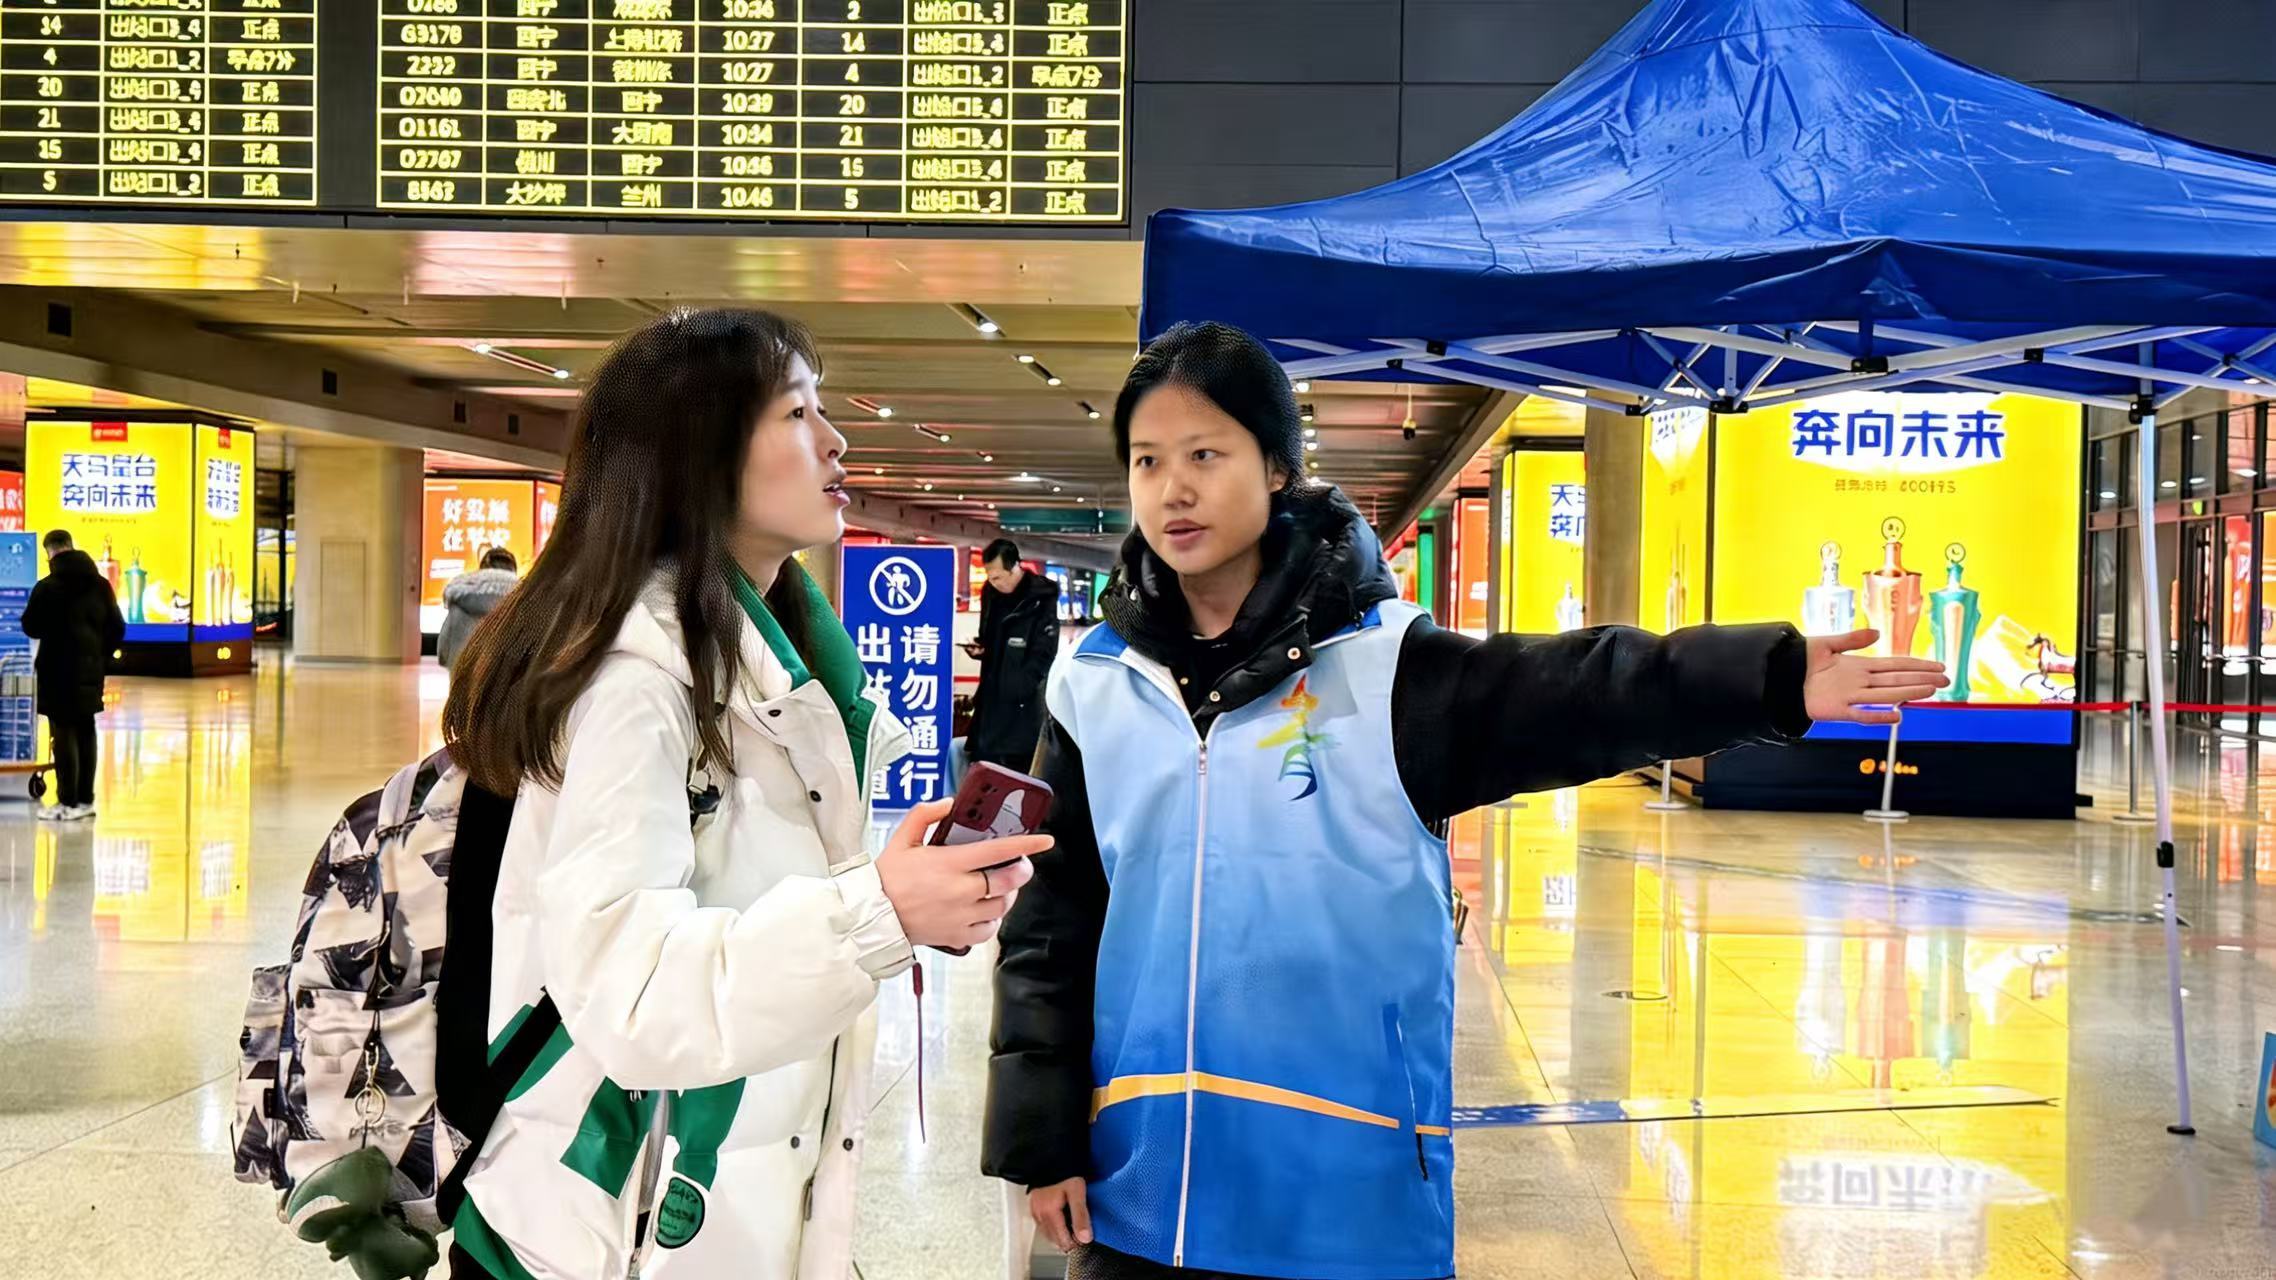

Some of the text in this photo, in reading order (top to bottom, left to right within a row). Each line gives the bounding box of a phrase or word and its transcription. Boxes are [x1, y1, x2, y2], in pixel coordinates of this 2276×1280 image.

[1048, 2, 1088, 24] 正点
[41, 15, 62, 35] 14
[841, 32, 865, 52] 14
[1047, 32, 1088, 55] 正点
[43, 48, 57, 65] 4
[845, 63, 859, 83] 4
[38, 76, 62, 97] 20
[839, 94, 865, 115] 20
[1046, 97, 1087, 118] 正点
[38, 108, 61, 128] 21
[839, 125, 864, 146] 21
[1045, 128, 1087, 149] 正点
[39, 139, 62, 159] 15
[841, 157, 864, 177] 15
[1045, 158, 1086, 180] 正点
[43, 170, 57, 191] 5
[621, 183, 661, 206] 兰州
[844, 188, 858, 209] 5
[1044, 190, 1086, 213] 正点
[1792, 409, 2005, 458] 奔向未来
[62, 483, 156, 508] 奔向未来
[900, 623, 941, 802] 请勿通行
